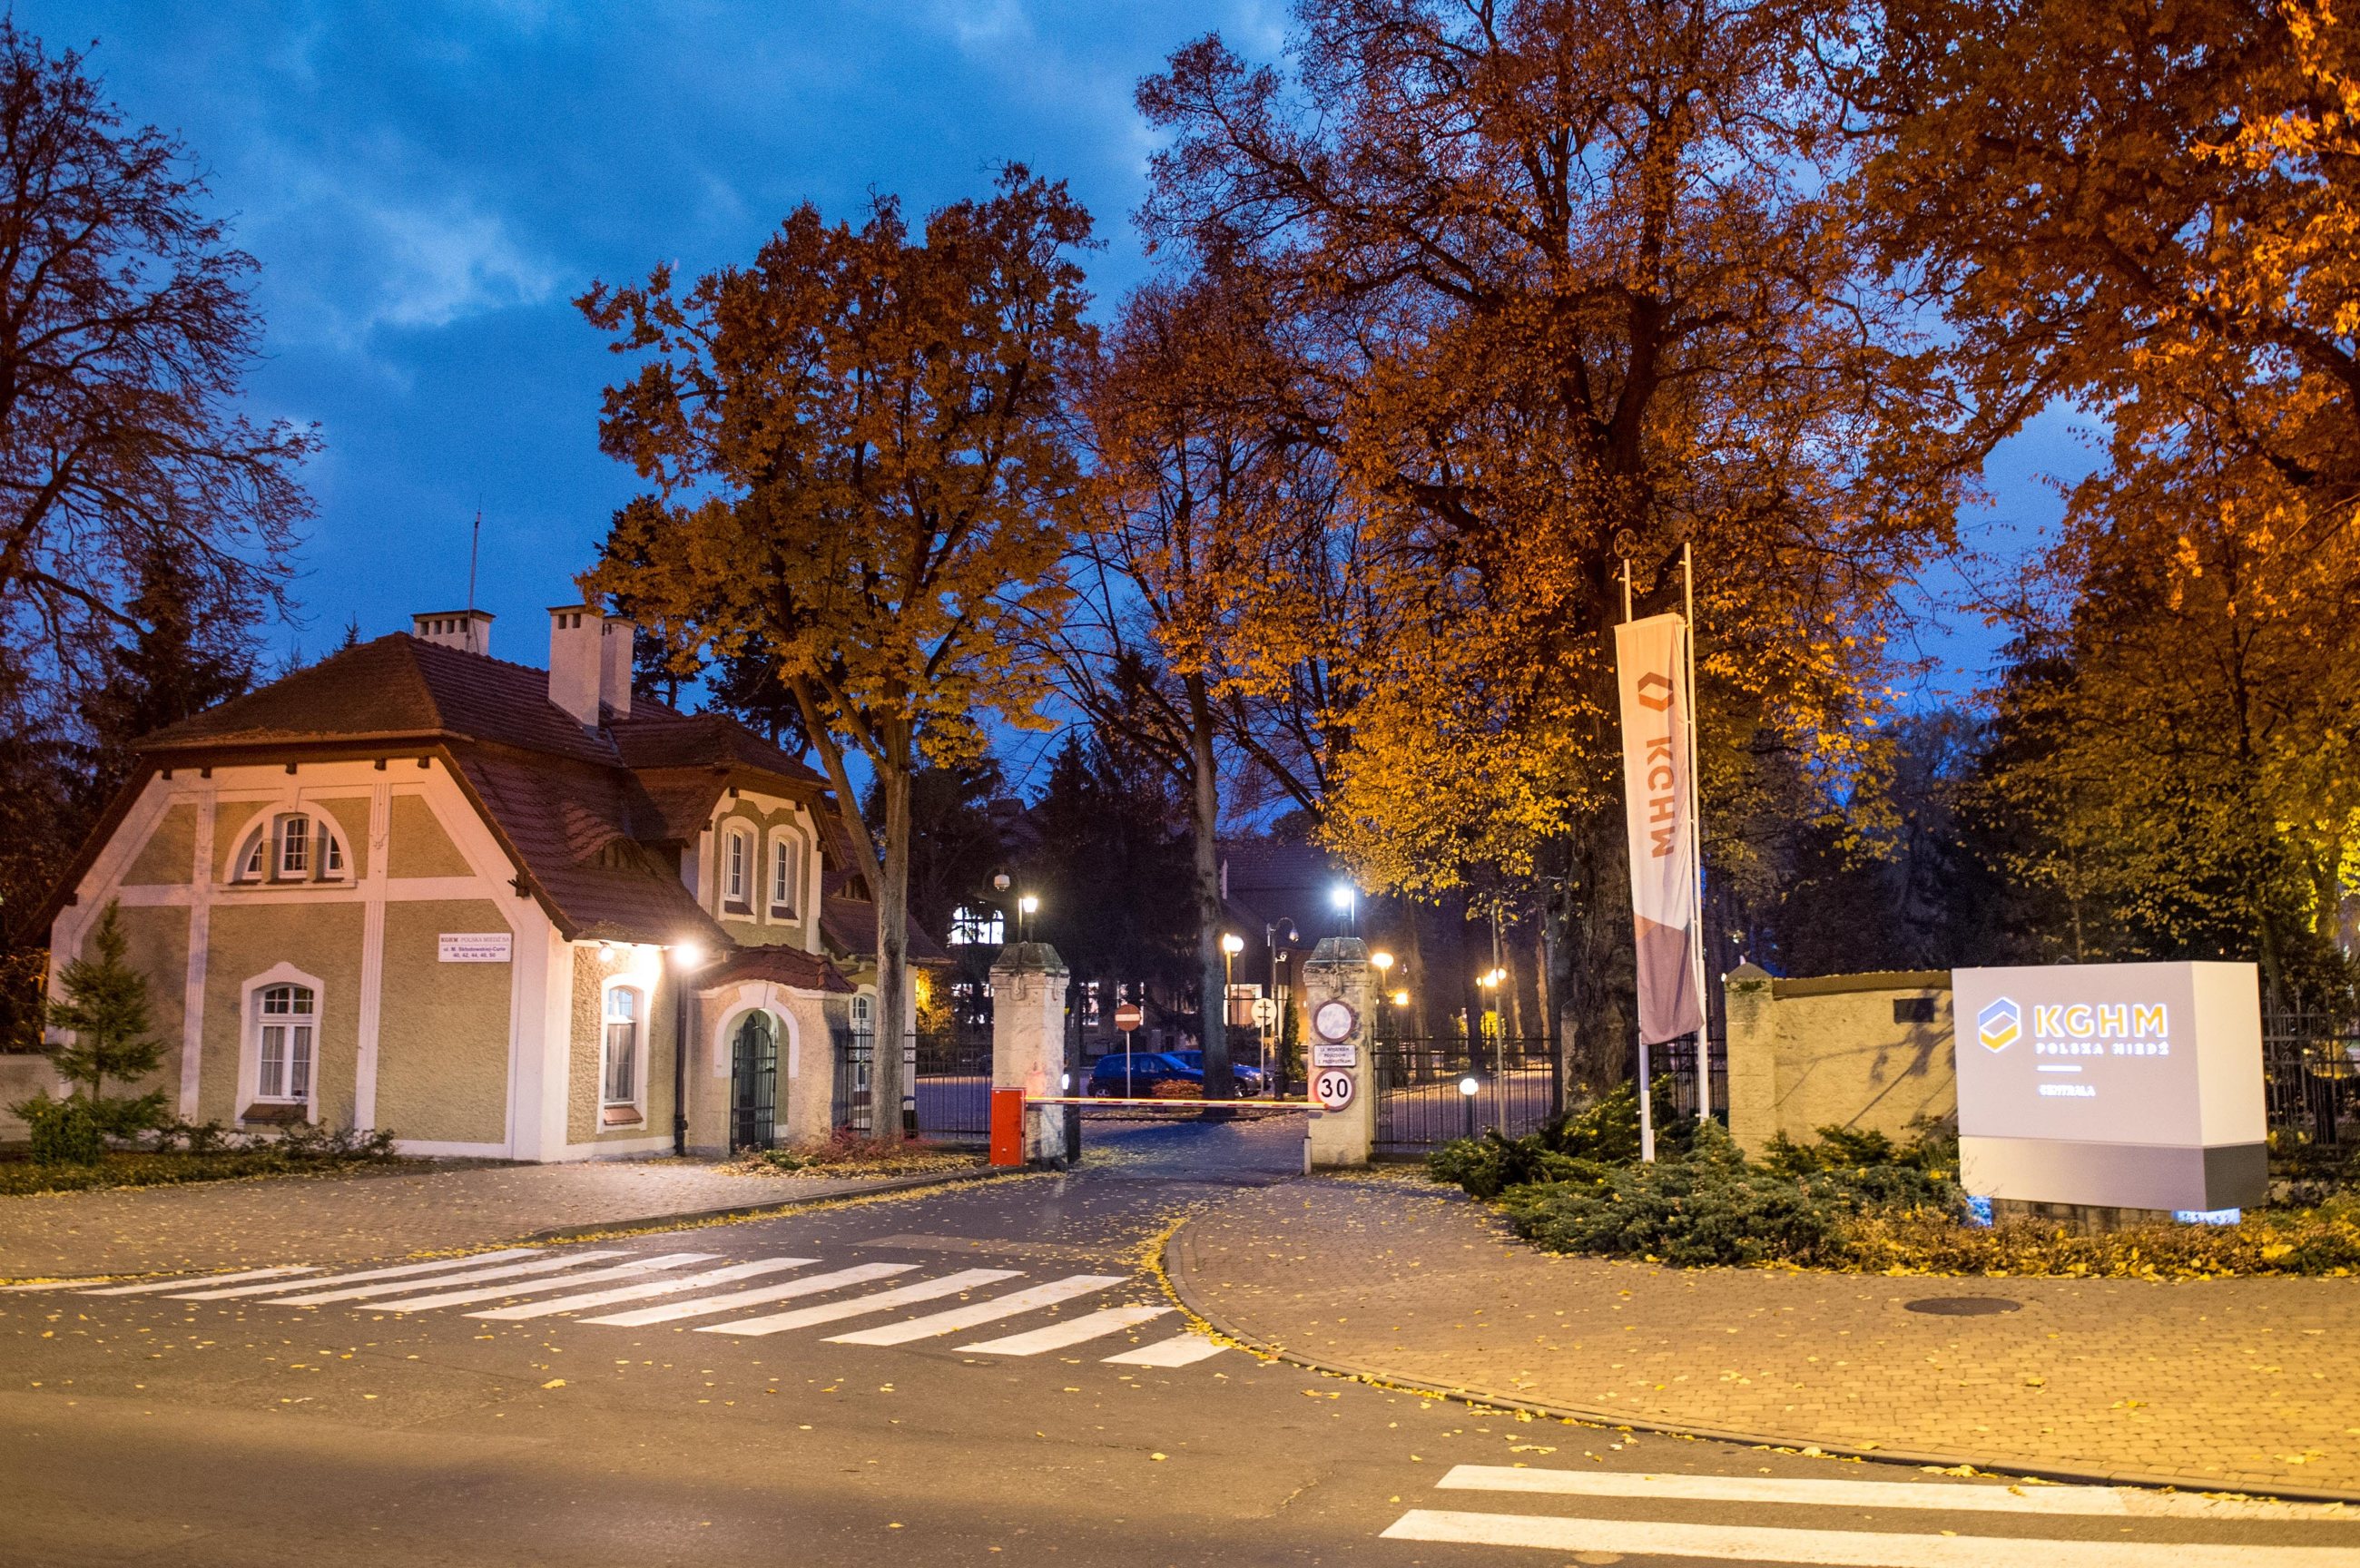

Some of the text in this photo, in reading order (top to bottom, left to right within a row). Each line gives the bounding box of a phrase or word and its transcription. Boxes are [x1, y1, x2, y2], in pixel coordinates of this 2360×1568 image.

[2033, 1003, 2168, 1038] KGHM
[2035, 1041, 2169, 1056] POLSKA MIEDŹ
[1321, 1078, 1349, 1098] 30
[2039, 1083, 2096, 1097] CENTRALA
